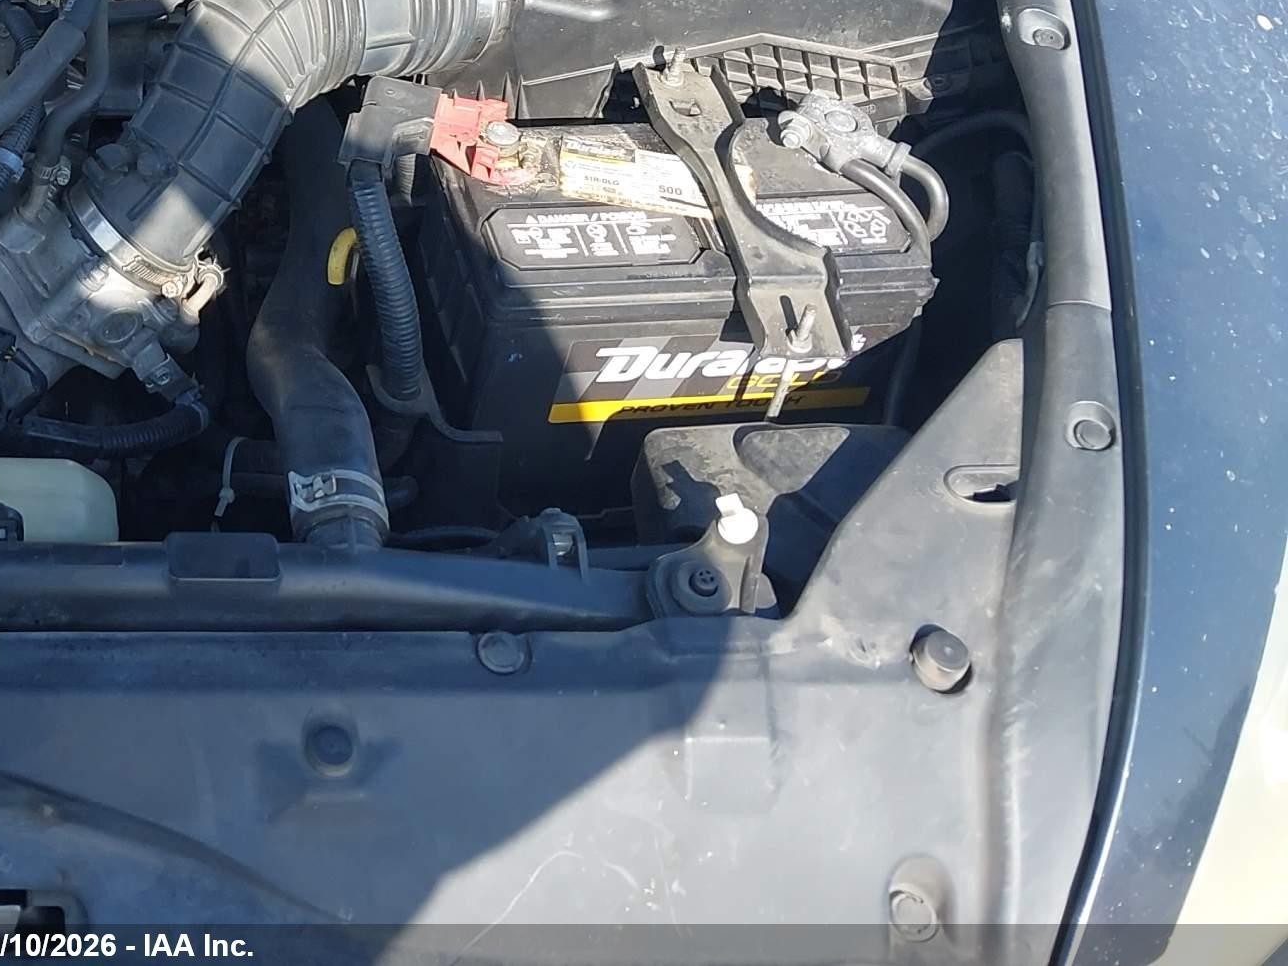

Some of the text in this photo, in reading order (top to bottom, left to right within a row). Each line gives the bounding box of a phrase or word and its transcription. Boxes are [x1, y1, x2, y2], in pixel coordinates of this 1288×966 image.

[658, 184, 684, 197] 500
[619, 394, 806, 416] PROVEN TOUH
